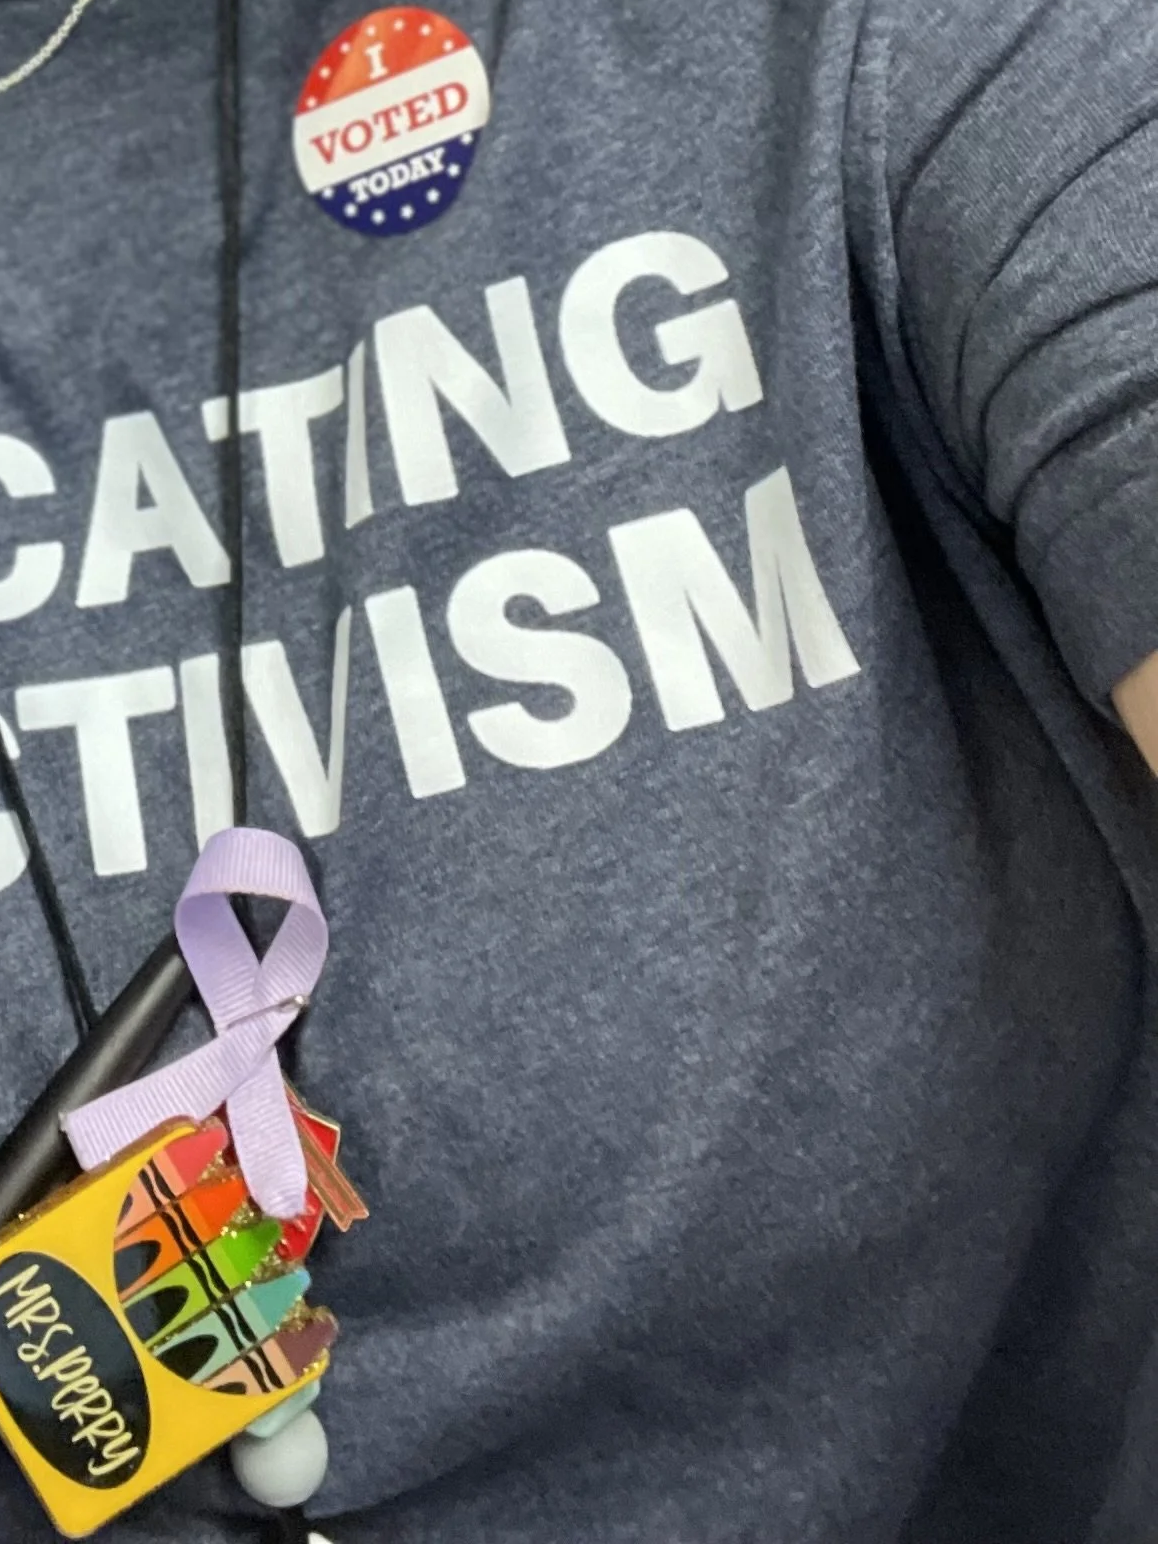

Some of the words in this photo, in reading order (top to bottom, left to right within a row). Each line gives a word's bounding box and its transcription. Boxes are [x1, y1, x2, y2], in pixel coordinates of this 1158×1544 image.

[363, 41, 389, 80] I
[308, 81, 469, 165] VOTED
[347, 147, 446, 203] TODAY
